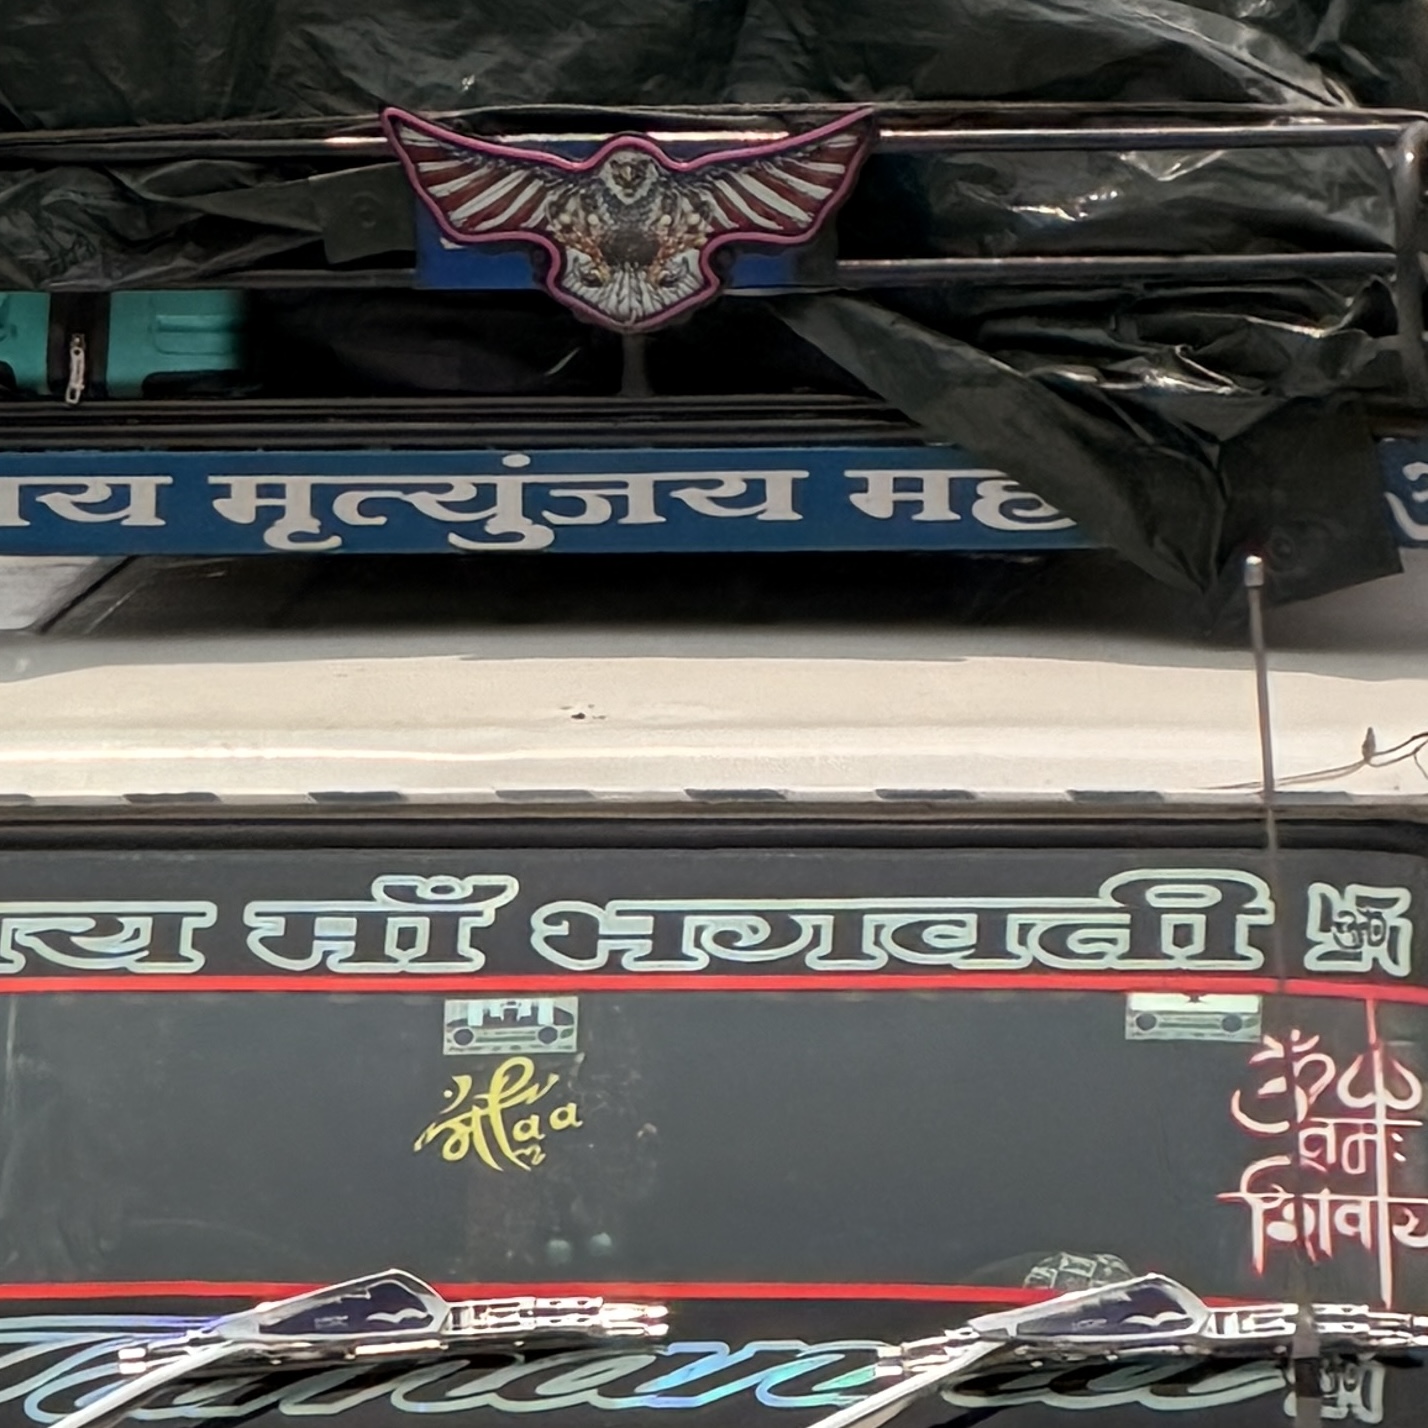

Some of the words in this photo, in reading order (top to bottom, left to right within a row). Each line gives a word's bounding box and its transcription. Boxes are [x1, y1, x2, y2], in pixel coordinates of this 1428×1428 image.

[207, 452, 810, 553] मृत्युंजय
[843, 468, 1079, 532] मह
[529, 868, 1275, 971] भगवती
